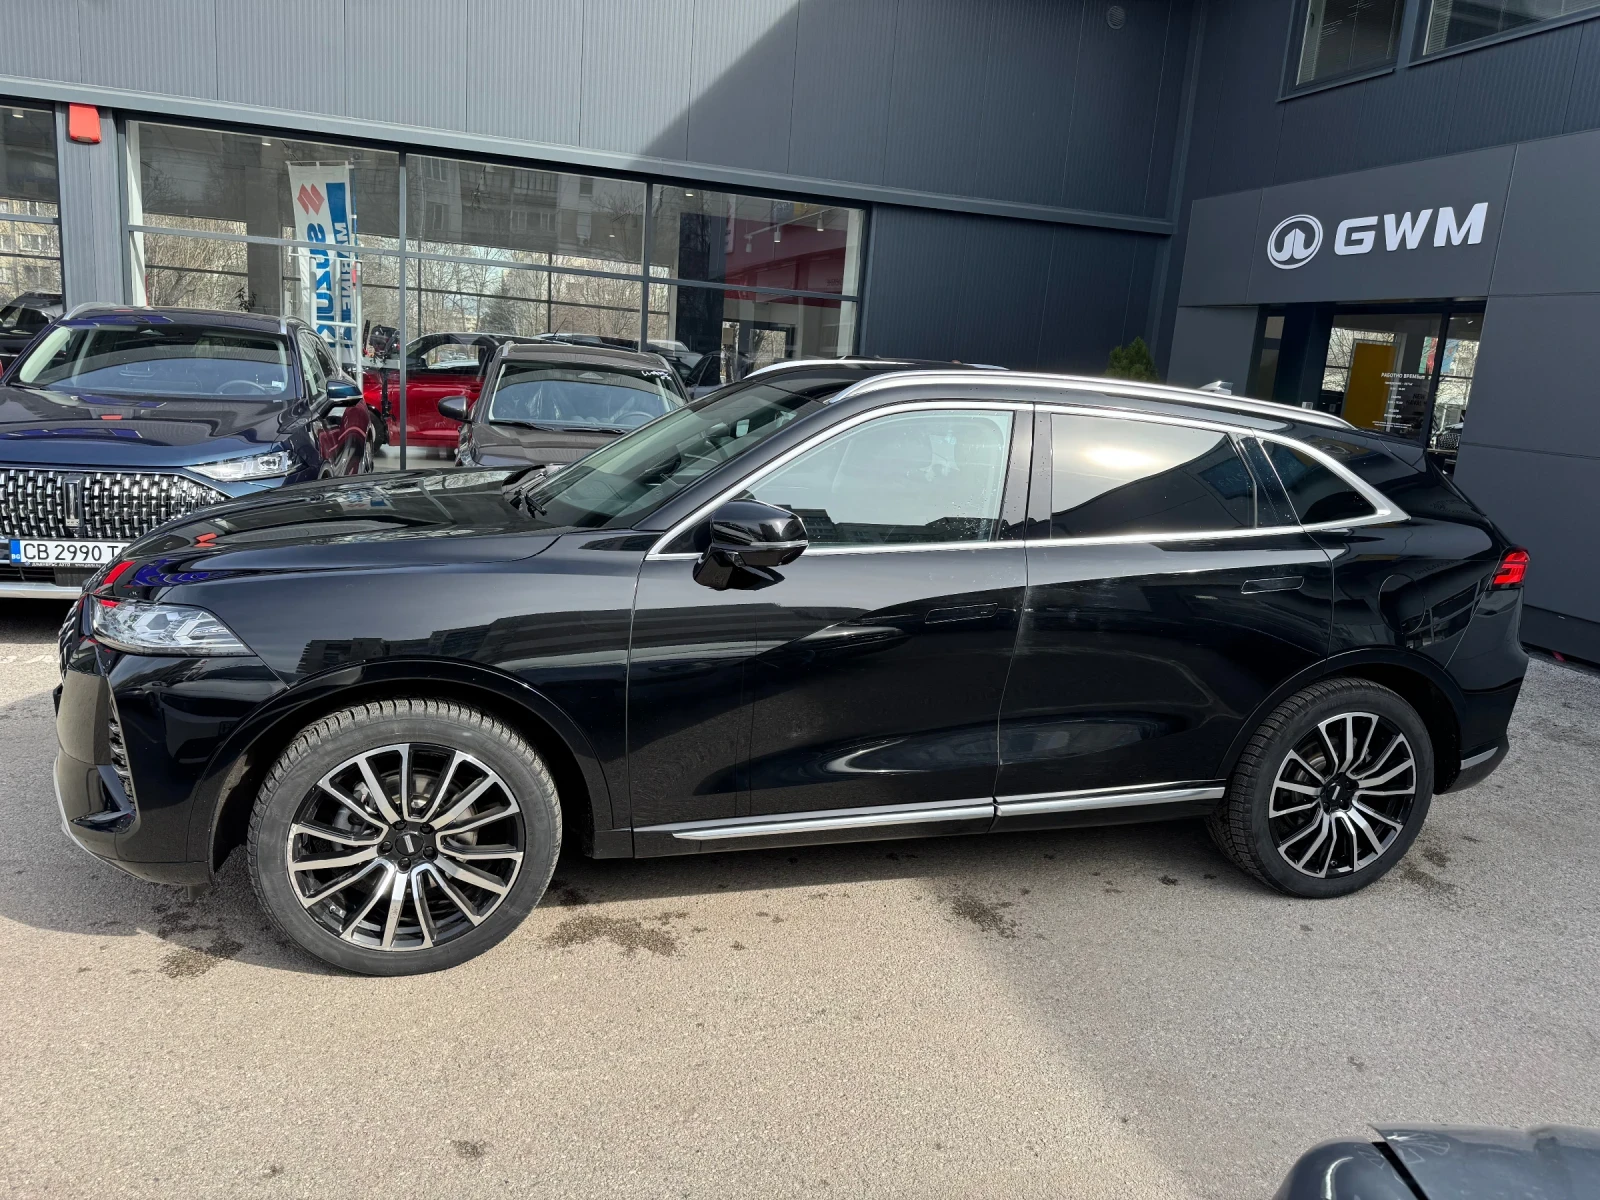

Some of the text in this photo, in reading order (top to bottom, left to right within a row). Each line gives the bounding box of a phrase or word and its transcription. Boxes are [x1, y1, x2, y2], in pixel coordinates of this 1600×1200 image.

[1334, 202, 1488, 256] GWM
[23, 543, 49, 560] CB
[55, 544, 102, 561] 2990
